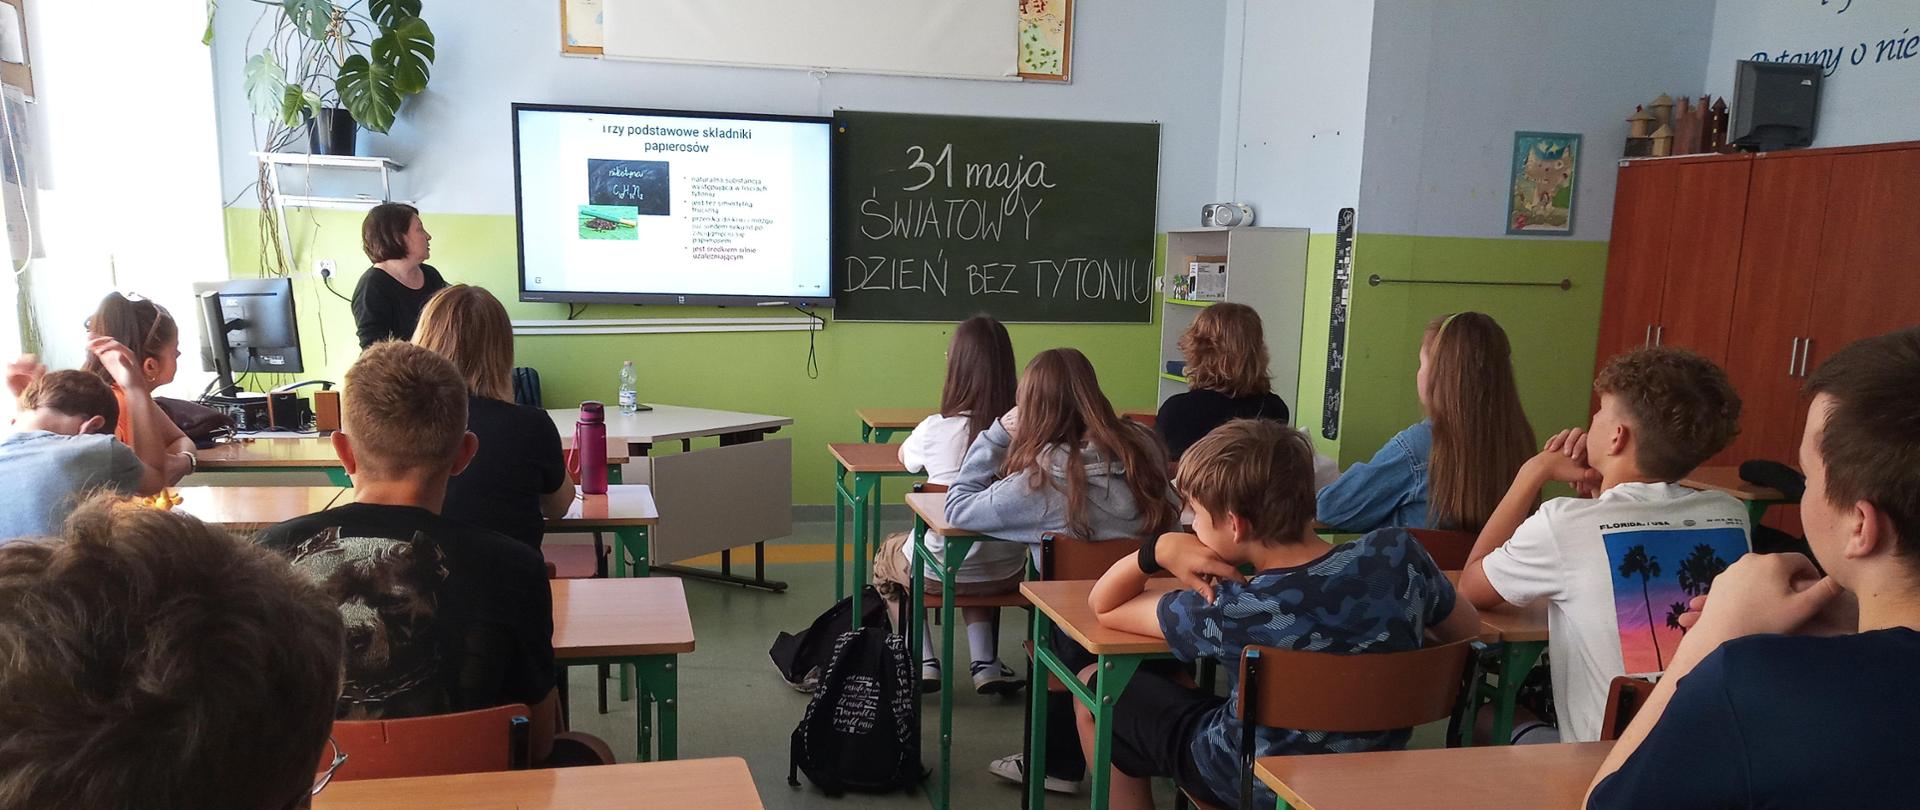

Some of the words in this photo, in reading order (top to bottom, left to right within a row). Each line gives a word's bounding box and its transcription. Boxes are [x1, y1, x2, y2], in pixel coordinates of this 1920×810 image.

[1851, 43, 1867, 66] o
[628, 124, 700, 137] podstawowe
[644, 141, 709, 153] papierosów
[903, 143, 953, 191] 31
[966, 154, 1057, 216] maja
[860, 187, 1043, 241] ŚWIATOWY
[842, 249, 948, 296] DZIEŃ
[966, 263, 1019, 296] BEZ
[1028, 257, 1153, 304] TYTONIU
